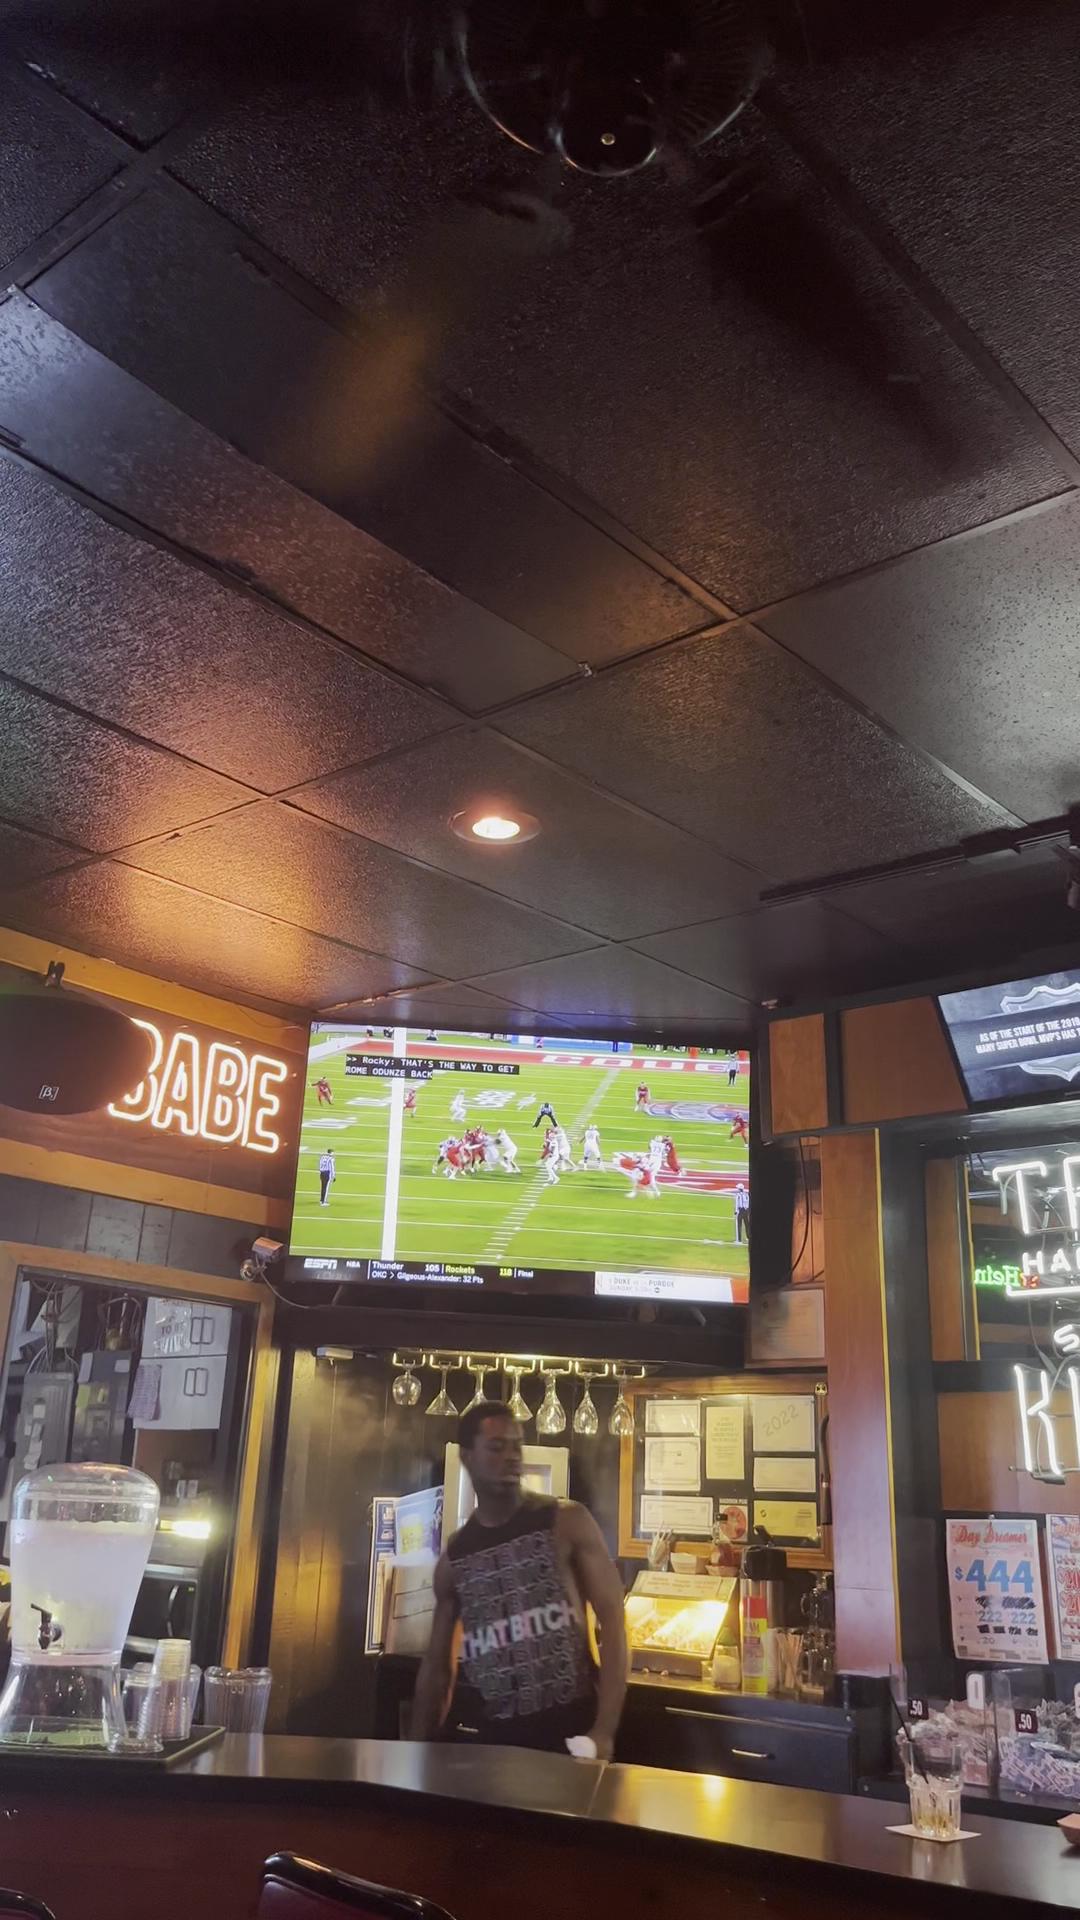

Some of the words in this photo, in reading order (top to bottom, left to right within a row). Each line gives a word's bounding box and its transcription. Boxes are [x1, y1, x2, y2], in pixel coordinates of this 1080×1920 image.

[979, 1033, 989, 1042] AS
[989, 1031, 998, 1040] OF
[998, 1029, 1013, 1039] THE
[1013, 1025, 1035, 1036] START
[1036, 1023, 1046, 1033] OF
[1046, 1020, 1060, 1031] THE
[976, 1043, 995, 1053] MANY
[996, 1039, 1018, 1050] SUPER
[1018, 1036, 1039, 1047] BOWL
[1039, 1032, 1061, 1043] MVP'S
[1061, 1029, 1076, 1040] HAS
[345, 1066, 367, 1074] ROME
[372, 1067, 405, 1076] ODUNZE
[411, 1070, 433, 1078] BACK
[363, 1056, 395, 1065] Rocky:
[401, 1058, 434, 1068] THAT'S
[439, 1061, 455, 1070] THE
[460, 1062, 476, 1071] WAY
[482, 1064, 493, 1072] TO
[498, 1065, 514, 1073] GET
[304, 1258, 338, 1270] ESPN
[346, 1260, 360, 1268] NBA
[372, 1261, 404, 1271] Thunder
[425, 1264, 440, 1272] 105
[445, 1265, 475, 1274] Rockets
[518, 1270, 533, 1278] Final
[1022, 1249, 1080, 1277] HA
[371, 1270, 387, 1279] OKC
[397, 1272, 461, 1282] Gilgeous-Alexander:
[463, 1275, 472, 1283] 32
[472, 1276, 484, 1284] Pts
[613, 1277, 631, 1285] DUKE
[762, 1404, 800, 1438] 2022
[956, 1525, 981, 1548] Day
[983, 1527, 1028, 1545] Dreamer
[909, 1700, 923, 1716] .50
[1018, 1714, 1032, 1730] .50
